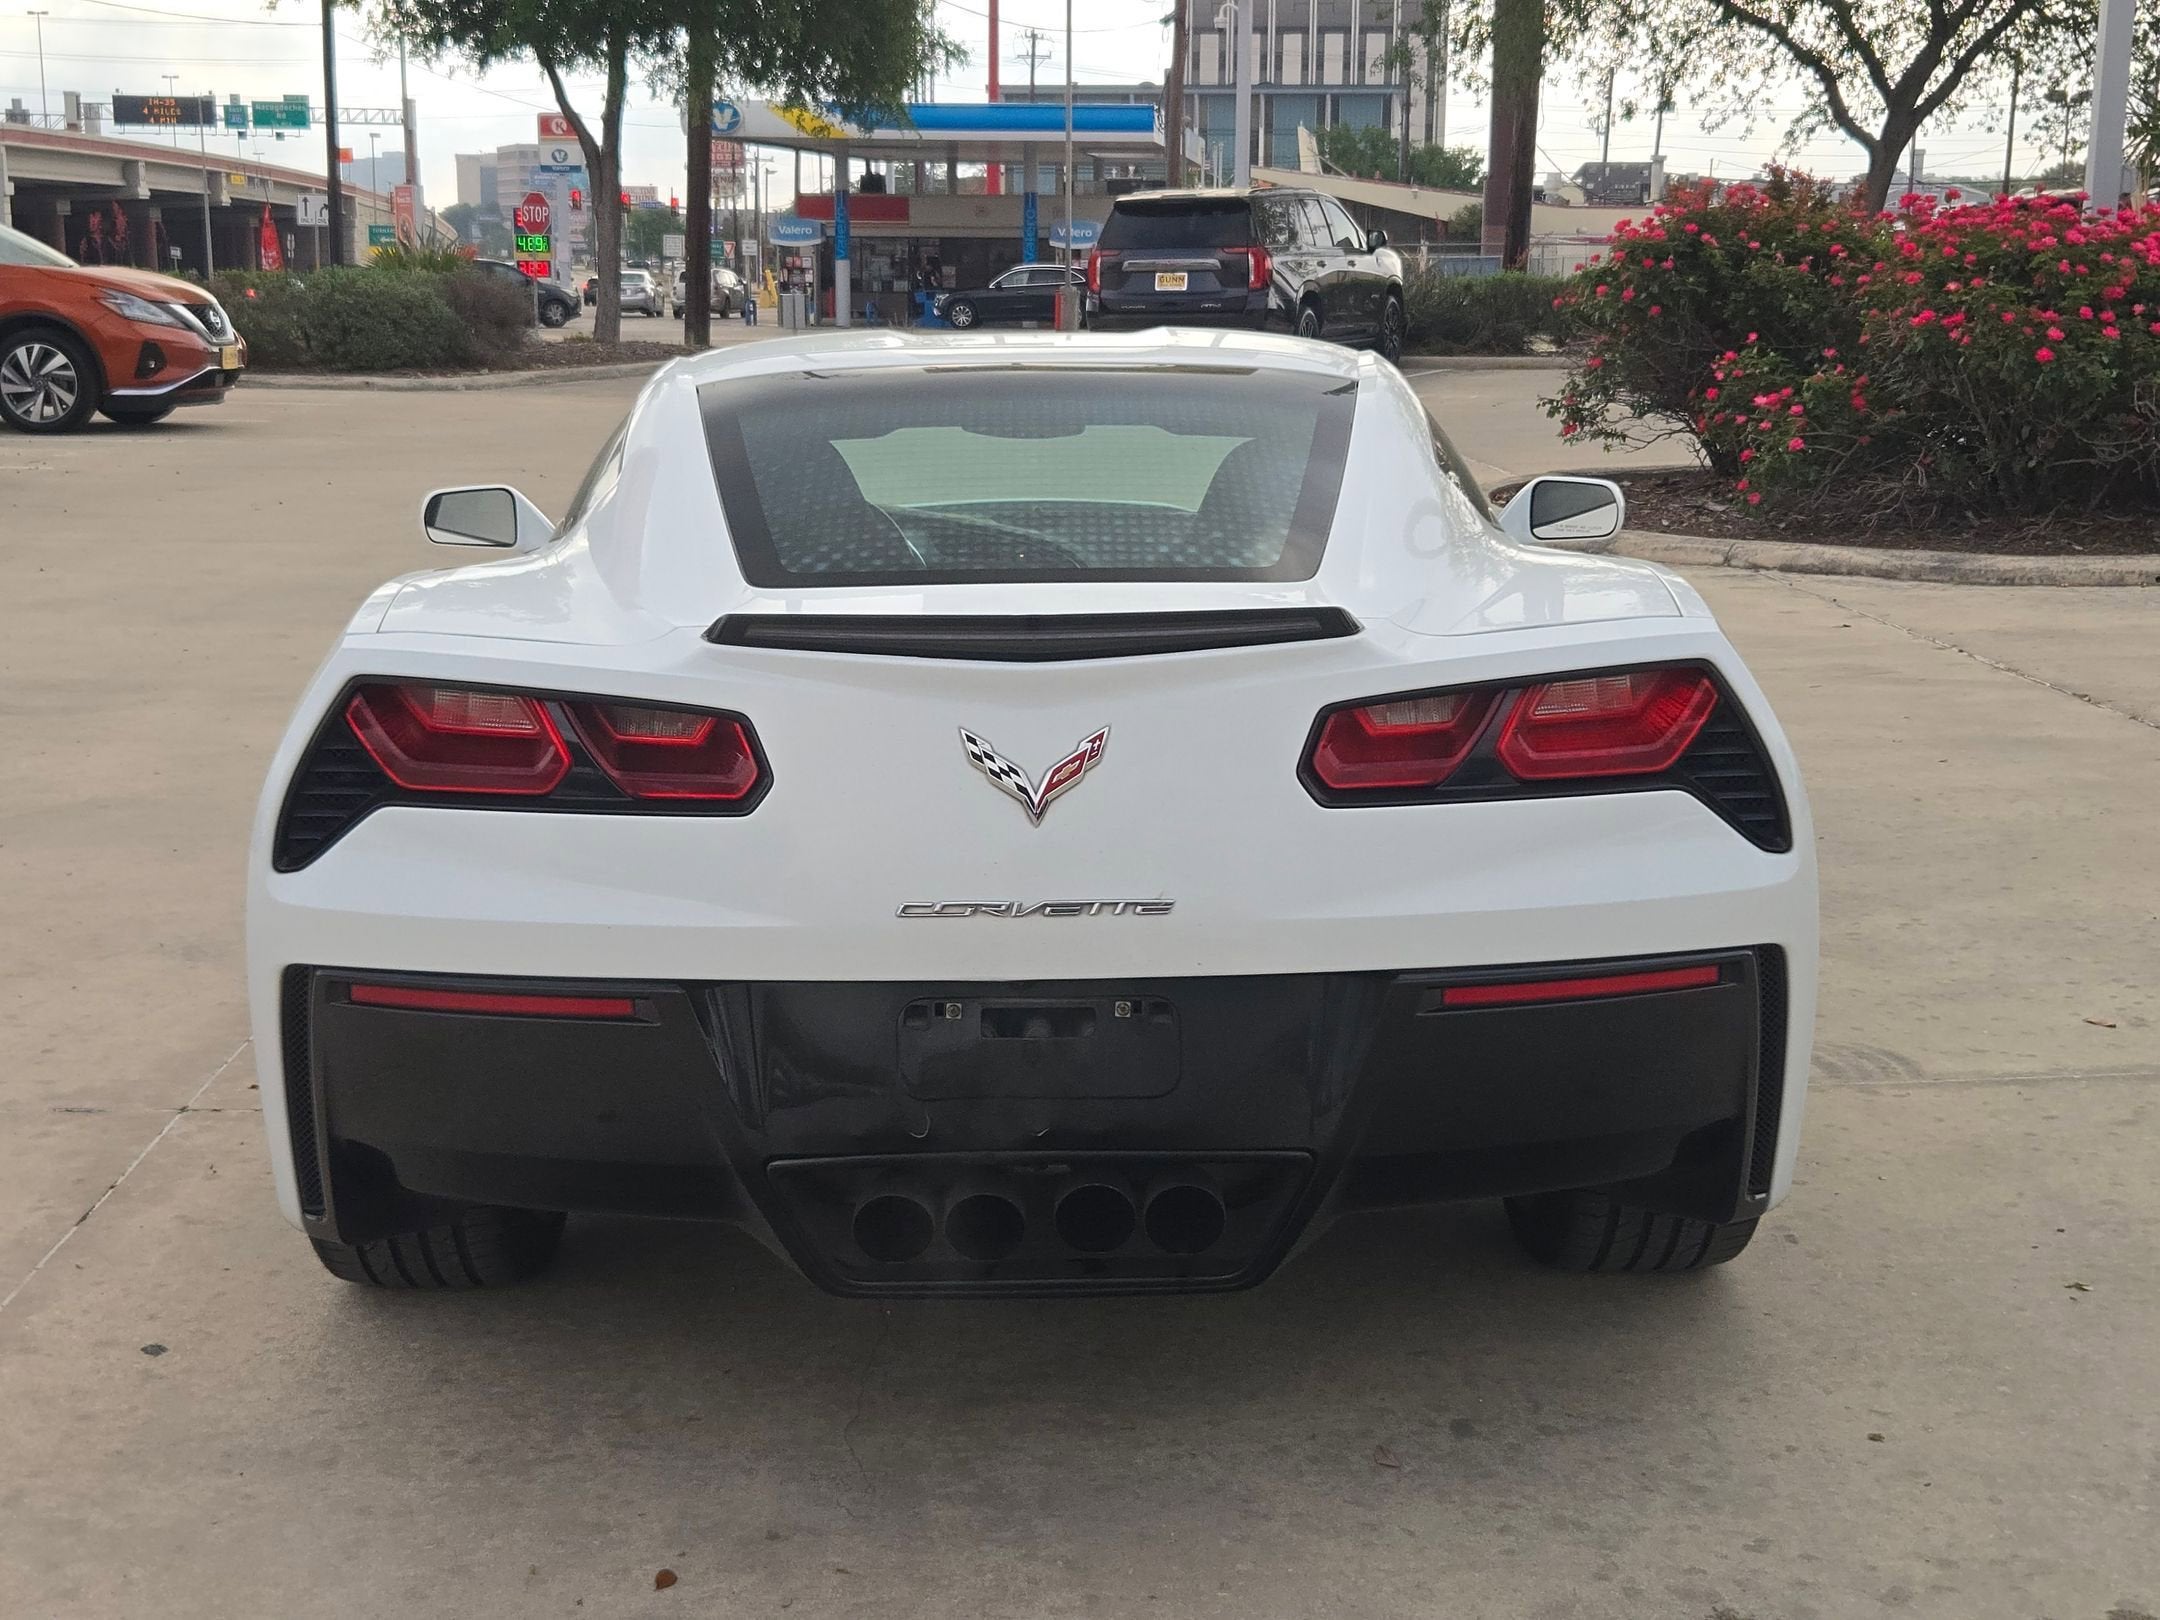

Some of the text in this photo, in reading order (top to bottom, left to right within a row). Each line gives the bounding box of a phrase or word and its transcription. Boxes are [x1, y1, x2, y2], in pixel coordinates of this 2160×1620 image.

[523, 206, 549, 223] STOP
[778, 225, 813, 235] Valero
[1057, 227, 1093, 238] Vlero
[895, 898, 1177, 918] CORVETTE
